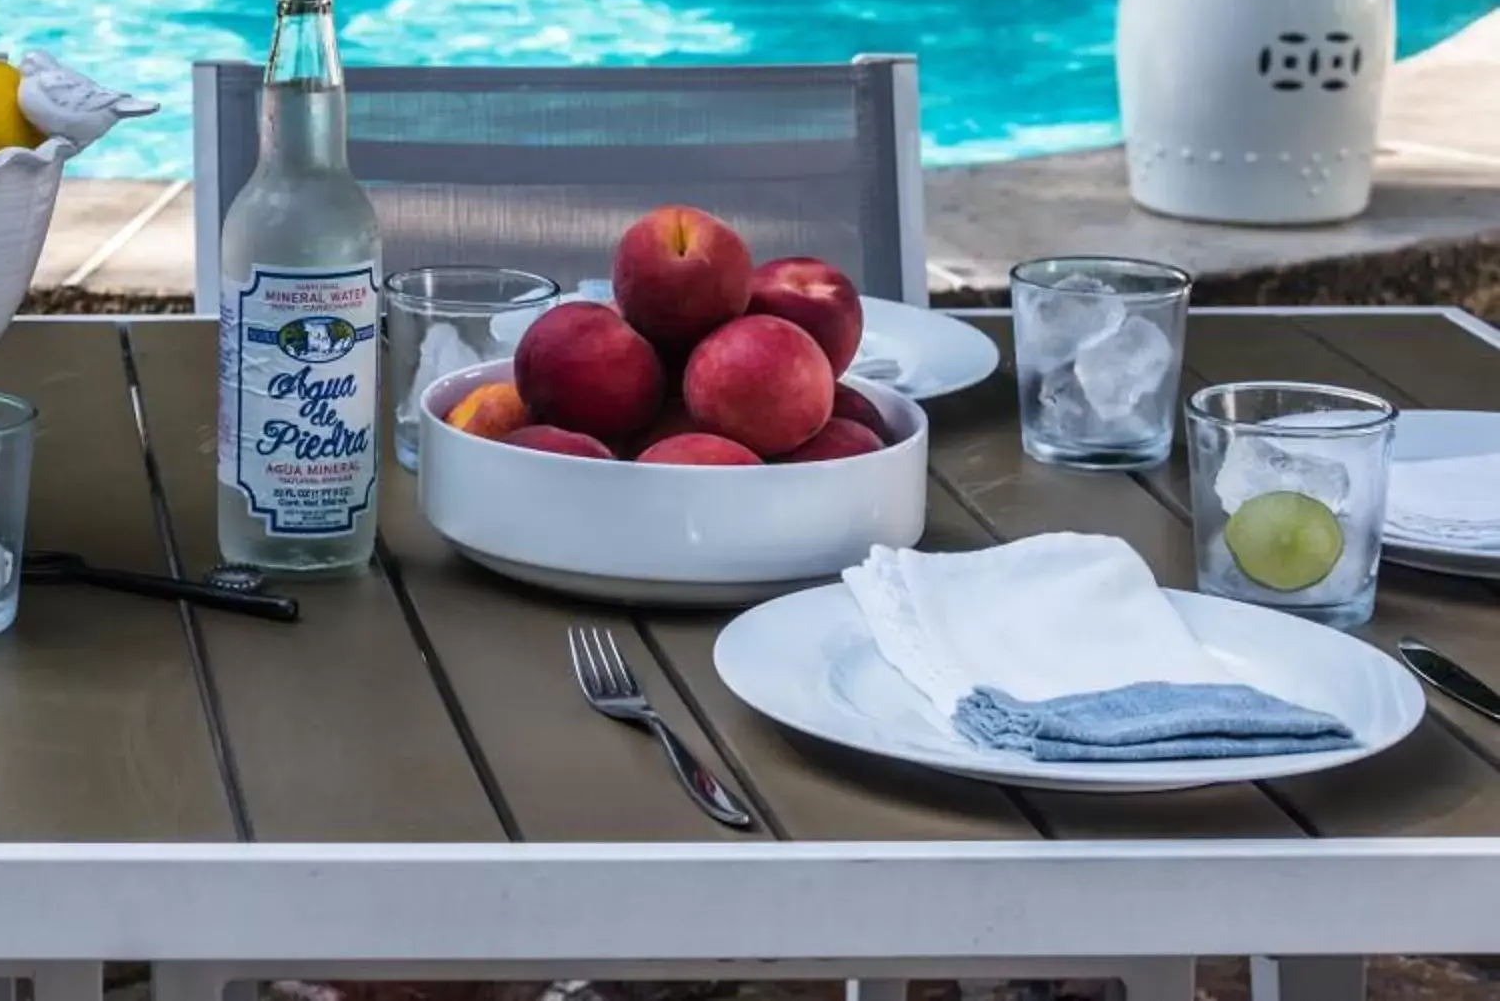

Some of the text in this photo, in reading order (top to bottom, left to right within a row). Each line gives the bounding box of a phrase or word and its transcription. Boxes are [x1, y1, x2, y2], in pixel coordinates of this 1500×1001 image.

[265, 286, 367, 304] MINERAL WATER
[267, 365, 358, 418] Agua
[310, 402, 339, 427] de
[256, 419, 368, 460] Piedra
[267, 461, 360, 475] AGUA MINERAL
